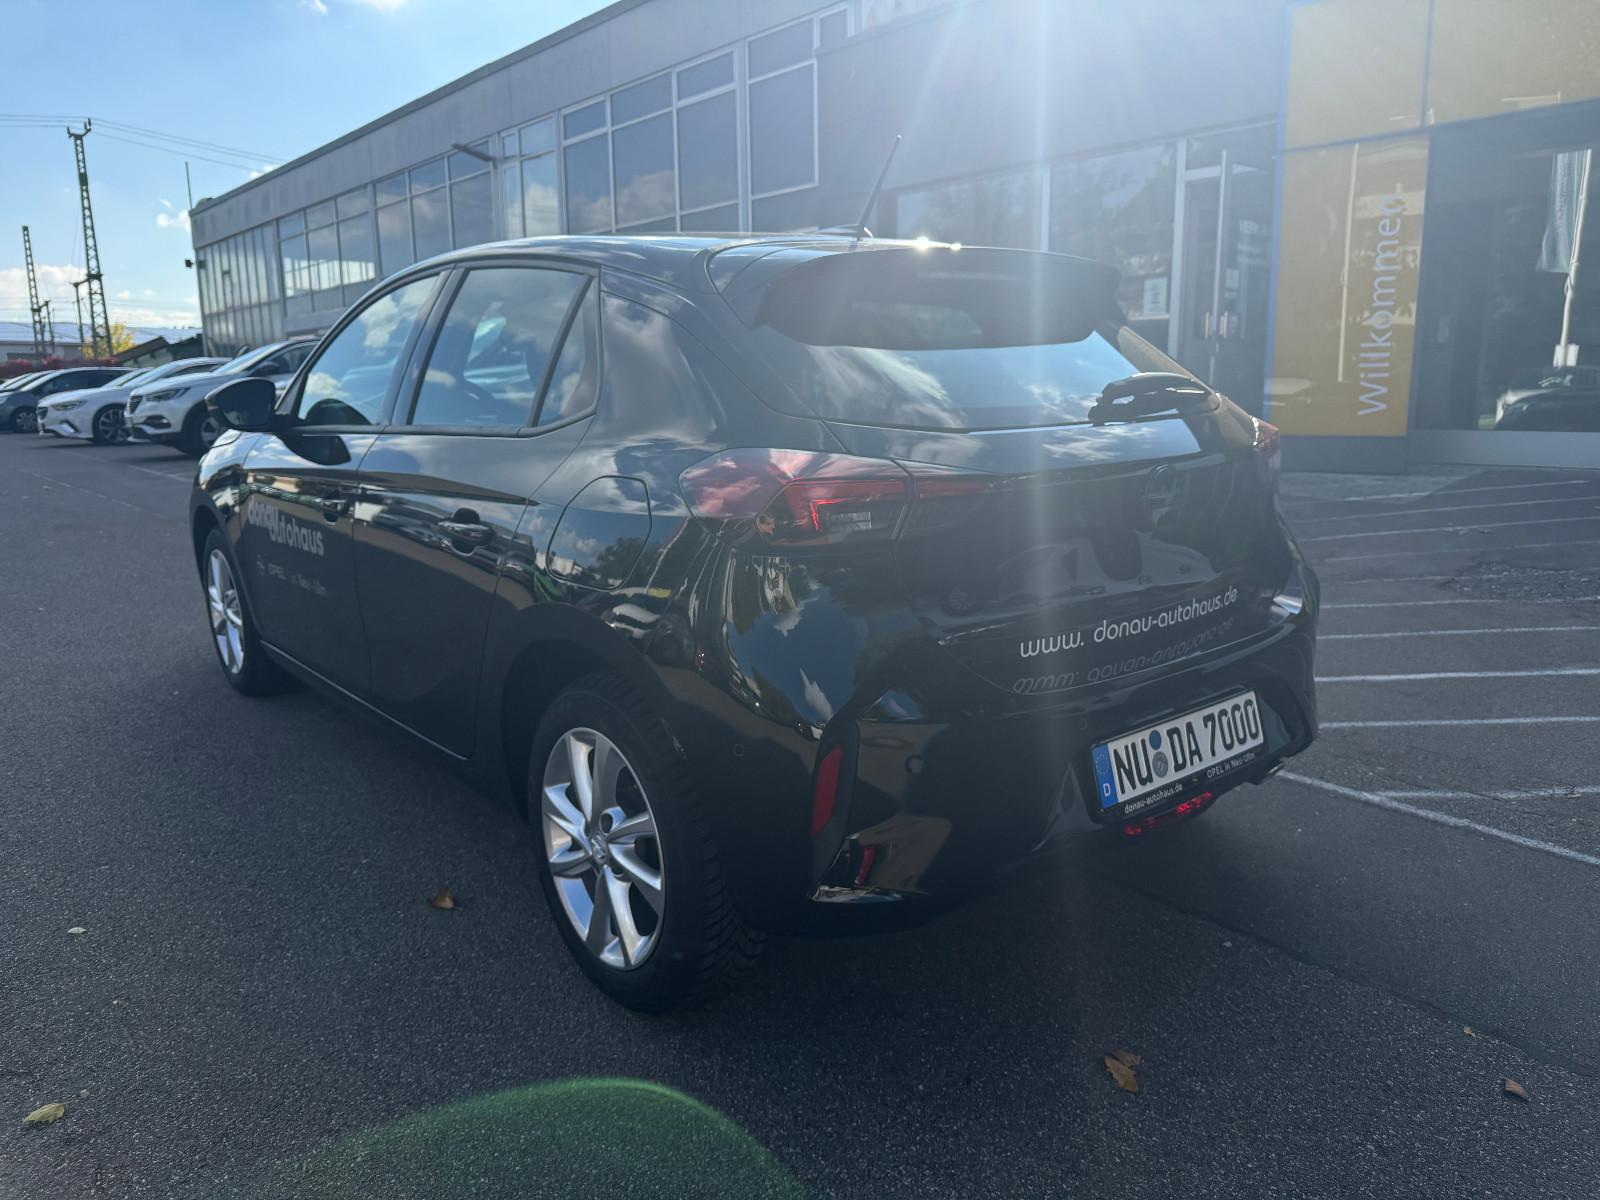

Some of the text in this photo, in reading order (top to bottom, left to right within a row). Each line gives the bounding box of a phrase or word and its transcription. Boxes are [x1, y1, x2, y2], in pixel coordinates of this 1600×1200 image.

[1357, 192, 1407, 416] Willkommen
[1019, 584, 1239, 658] www. donau-autohaus.de
[1112, 698, 1260, 794] NU DA 7000
[1206, 765, 1224, 779] OPEL
[1102, 782, 1111, 797] D
[1124, 782, 1184, 814] donau-autohaus.de
